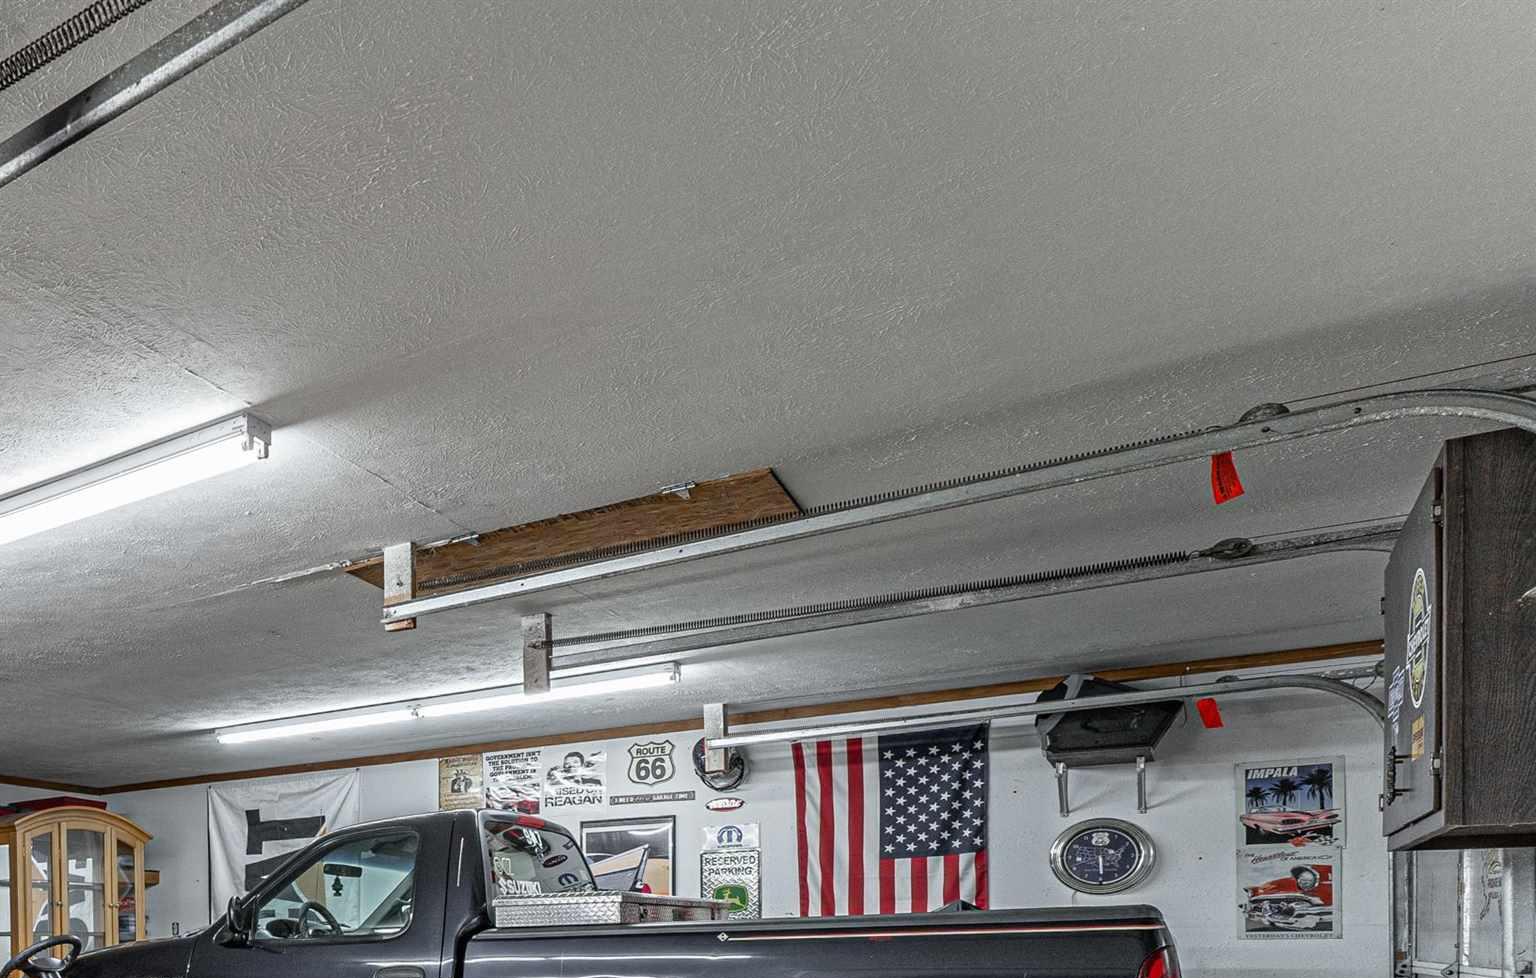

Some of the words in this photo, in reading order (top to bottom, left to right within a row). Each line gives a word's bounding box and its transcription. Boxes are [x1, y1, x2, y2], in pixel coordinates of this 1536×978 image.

[635, 746, 667, 755] ROUTE
[635, 757, 667, 781] 66
[1247, 766, 1298, 779] IMPALA
[544, 795, 603, 808] REAGAN
[704, 855, 756, 867] RESERVED
[708, 866, 753, 876] PARKING
[507, 880, 542, 895] SUZUKI
